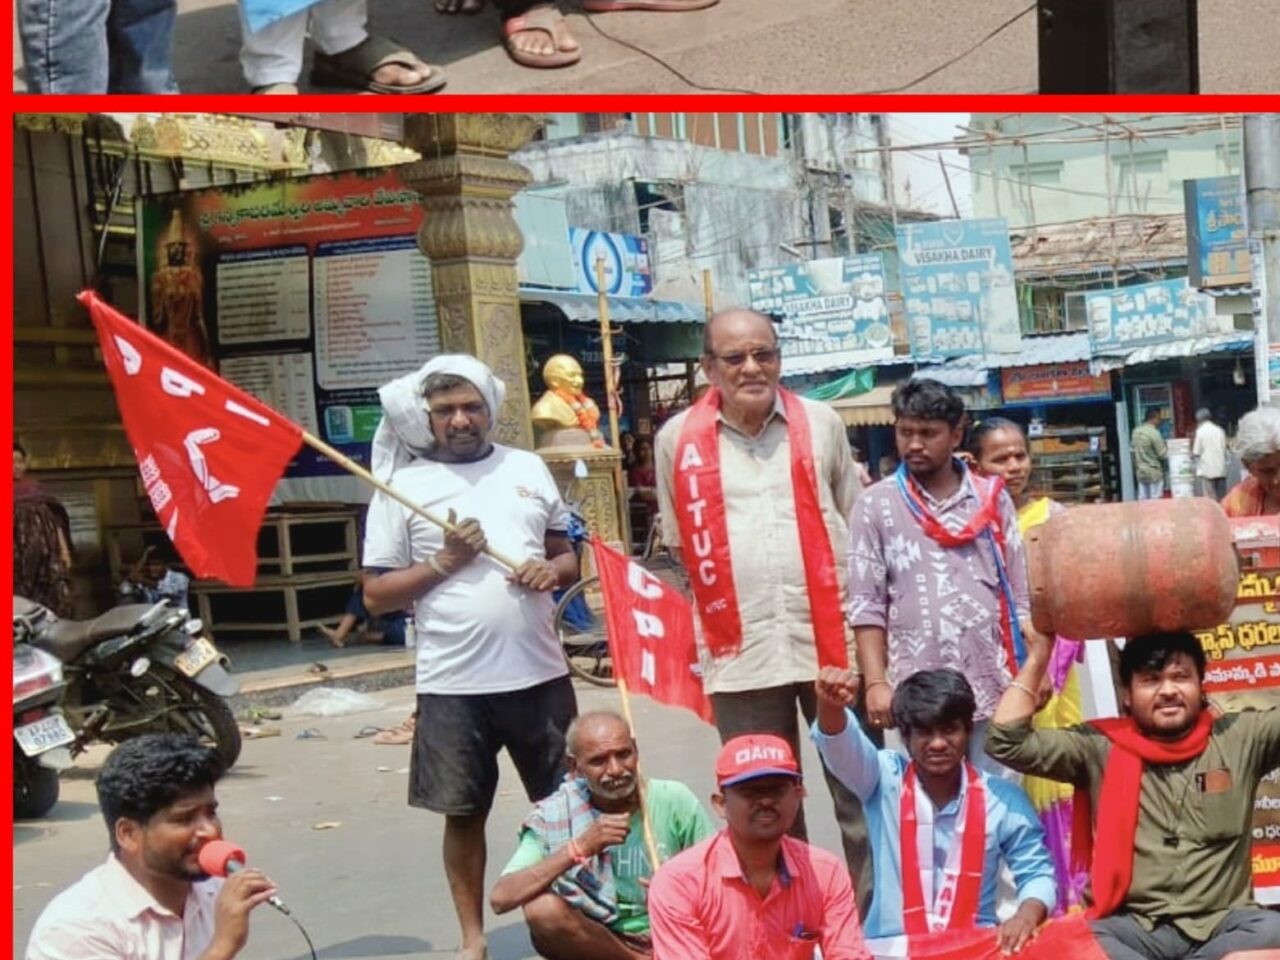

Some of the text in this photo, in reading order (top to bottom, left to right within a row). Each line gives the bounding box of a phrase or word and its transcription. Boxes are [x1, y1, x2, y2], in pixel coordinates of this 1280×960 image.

[914, 245, 993, 266] VISAKHA DAIRY
[824, 295, 850, 310] DAIRY
[680, 442, 717, 586] AITUC
[628, 561, 665, 686] CPI
